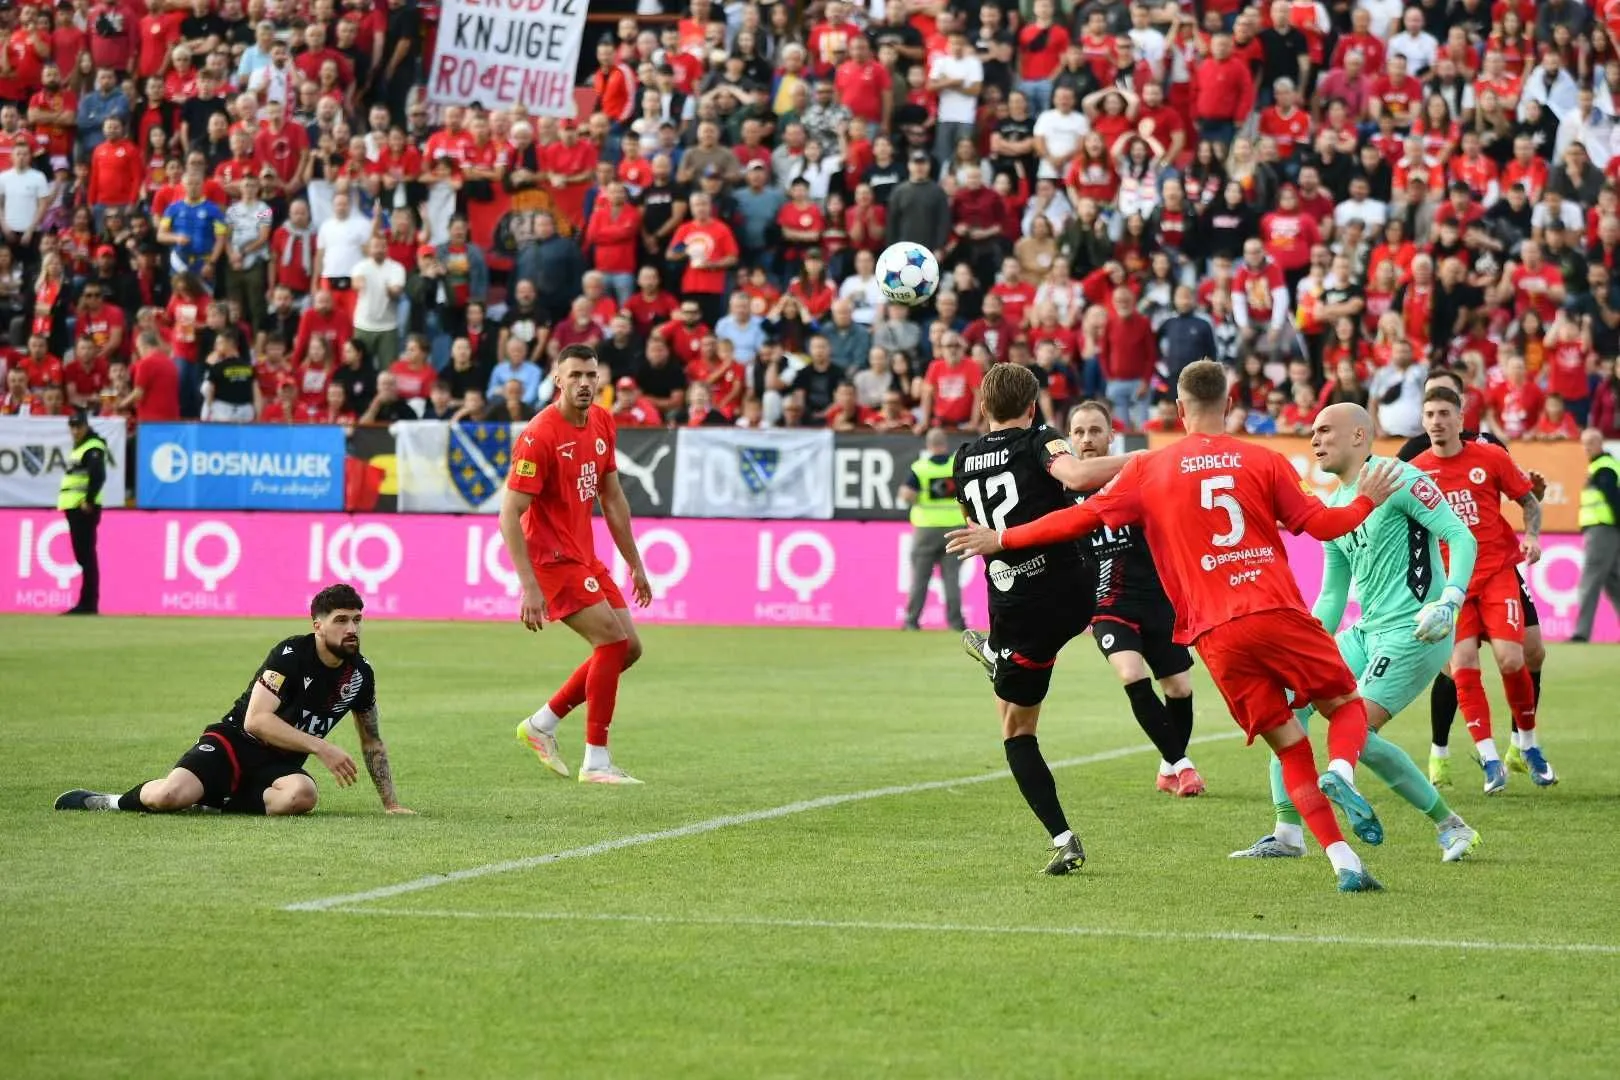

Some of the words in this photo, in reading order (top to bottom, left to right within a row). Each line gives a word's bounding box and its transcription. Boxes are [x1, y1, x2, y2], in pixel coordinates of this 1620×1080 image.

[454, 13, 566, 61] KNJIGE
[580, 461, 596, 477] na
[964, 448, 1009, 473] MAMIĆ
[1180, 452, 1243, 474] ŠERBEČIĆ
[576, 473, 598, 490] ren
[964, 471, 1020, 534] 12
[1446, 489, 1473, 504] na
[1200, 475, 1246, 548] 5
[163, 520, 242, 592] IQ
[611, 528, 691, 599] IQ
[757, 530, 836, 602] IQ
[16, 590, 74, 608] MOBIL
[162, 592, 238, 610] MOBILE
[755, 602, 833, 622] MOBILE
